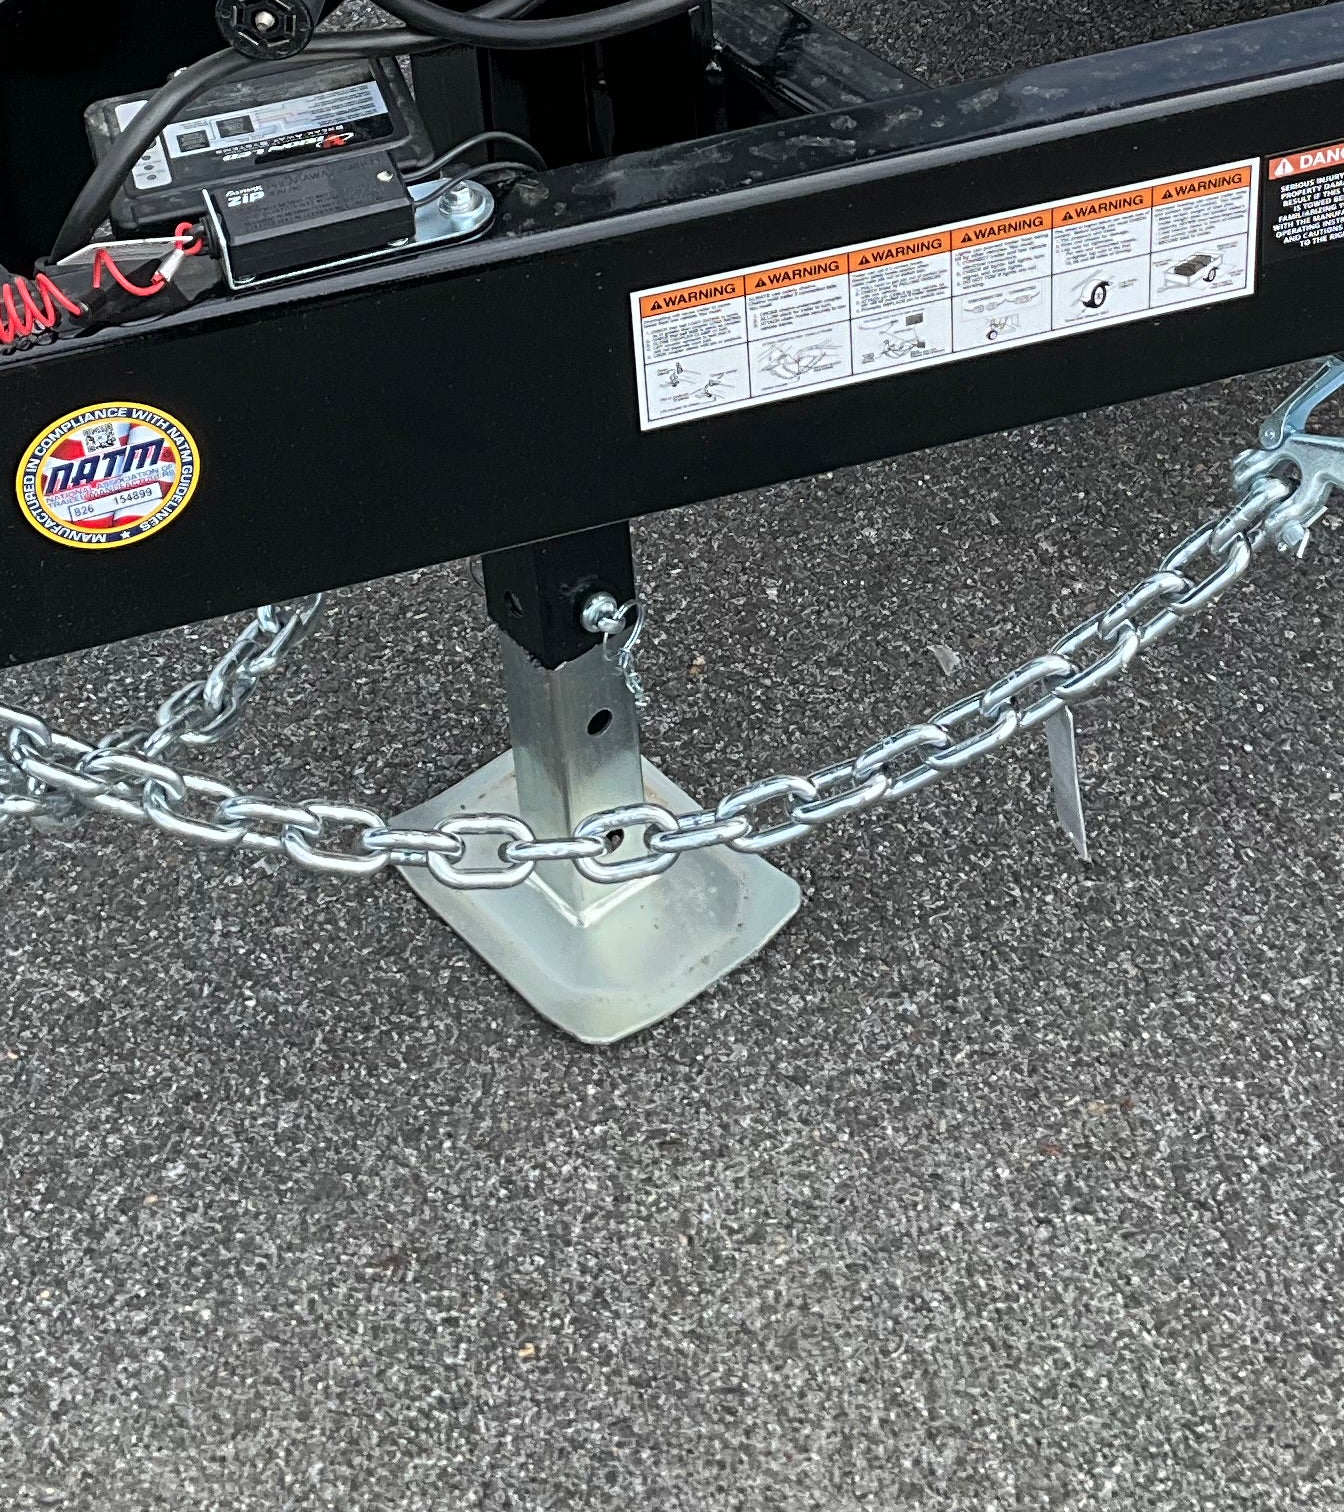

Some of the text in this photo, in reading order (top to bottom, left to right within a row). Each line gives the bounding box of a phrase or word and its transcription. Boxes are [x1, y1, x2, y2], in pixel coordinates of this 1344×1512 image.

[1175, 174, 1242, 196] WARNING
[1280, 179, 1314, 192] SERIOUS
[1316, 172, 1344, 184] INJURY
[1280, 185, 1321, 199] PROPERTY
[1075, 195, 1143, 218] WARNING
[1282, 194, 1311, 206] RESULT
[1322, 188, 1340, 197] THIS
[1302, 198, 1330, 209] TOWED
[974, 216, 1043, 239] WARNING
[1272, 221, 1293, 231] WITH
[1296, 217, 1310, 225] THE
[1275, 222, 1320, 238] OPERATING
[1283, 234, 1301, 243] AND
[1302, 224, 1342, 239] CAUTIONS
[871, 238, 942, 262] WARNING
[1300, 239, 1311, 247] TO
[1312, 235, 1327, 244] THE
[768, 261, 839, 284] WARNING
[663, 283, 736, 307] WARNING
[24, 408, 194, 543] MANUFACTURED IN COMPLIANCE WITH NATM GUIDELINES
[44, 438, 165, 494] NATM
[46, 486, 94, 503] NATIONAL
[96, 469, 159, 489] ASSOCIATION
[114, 488, 153, 505] 154899
